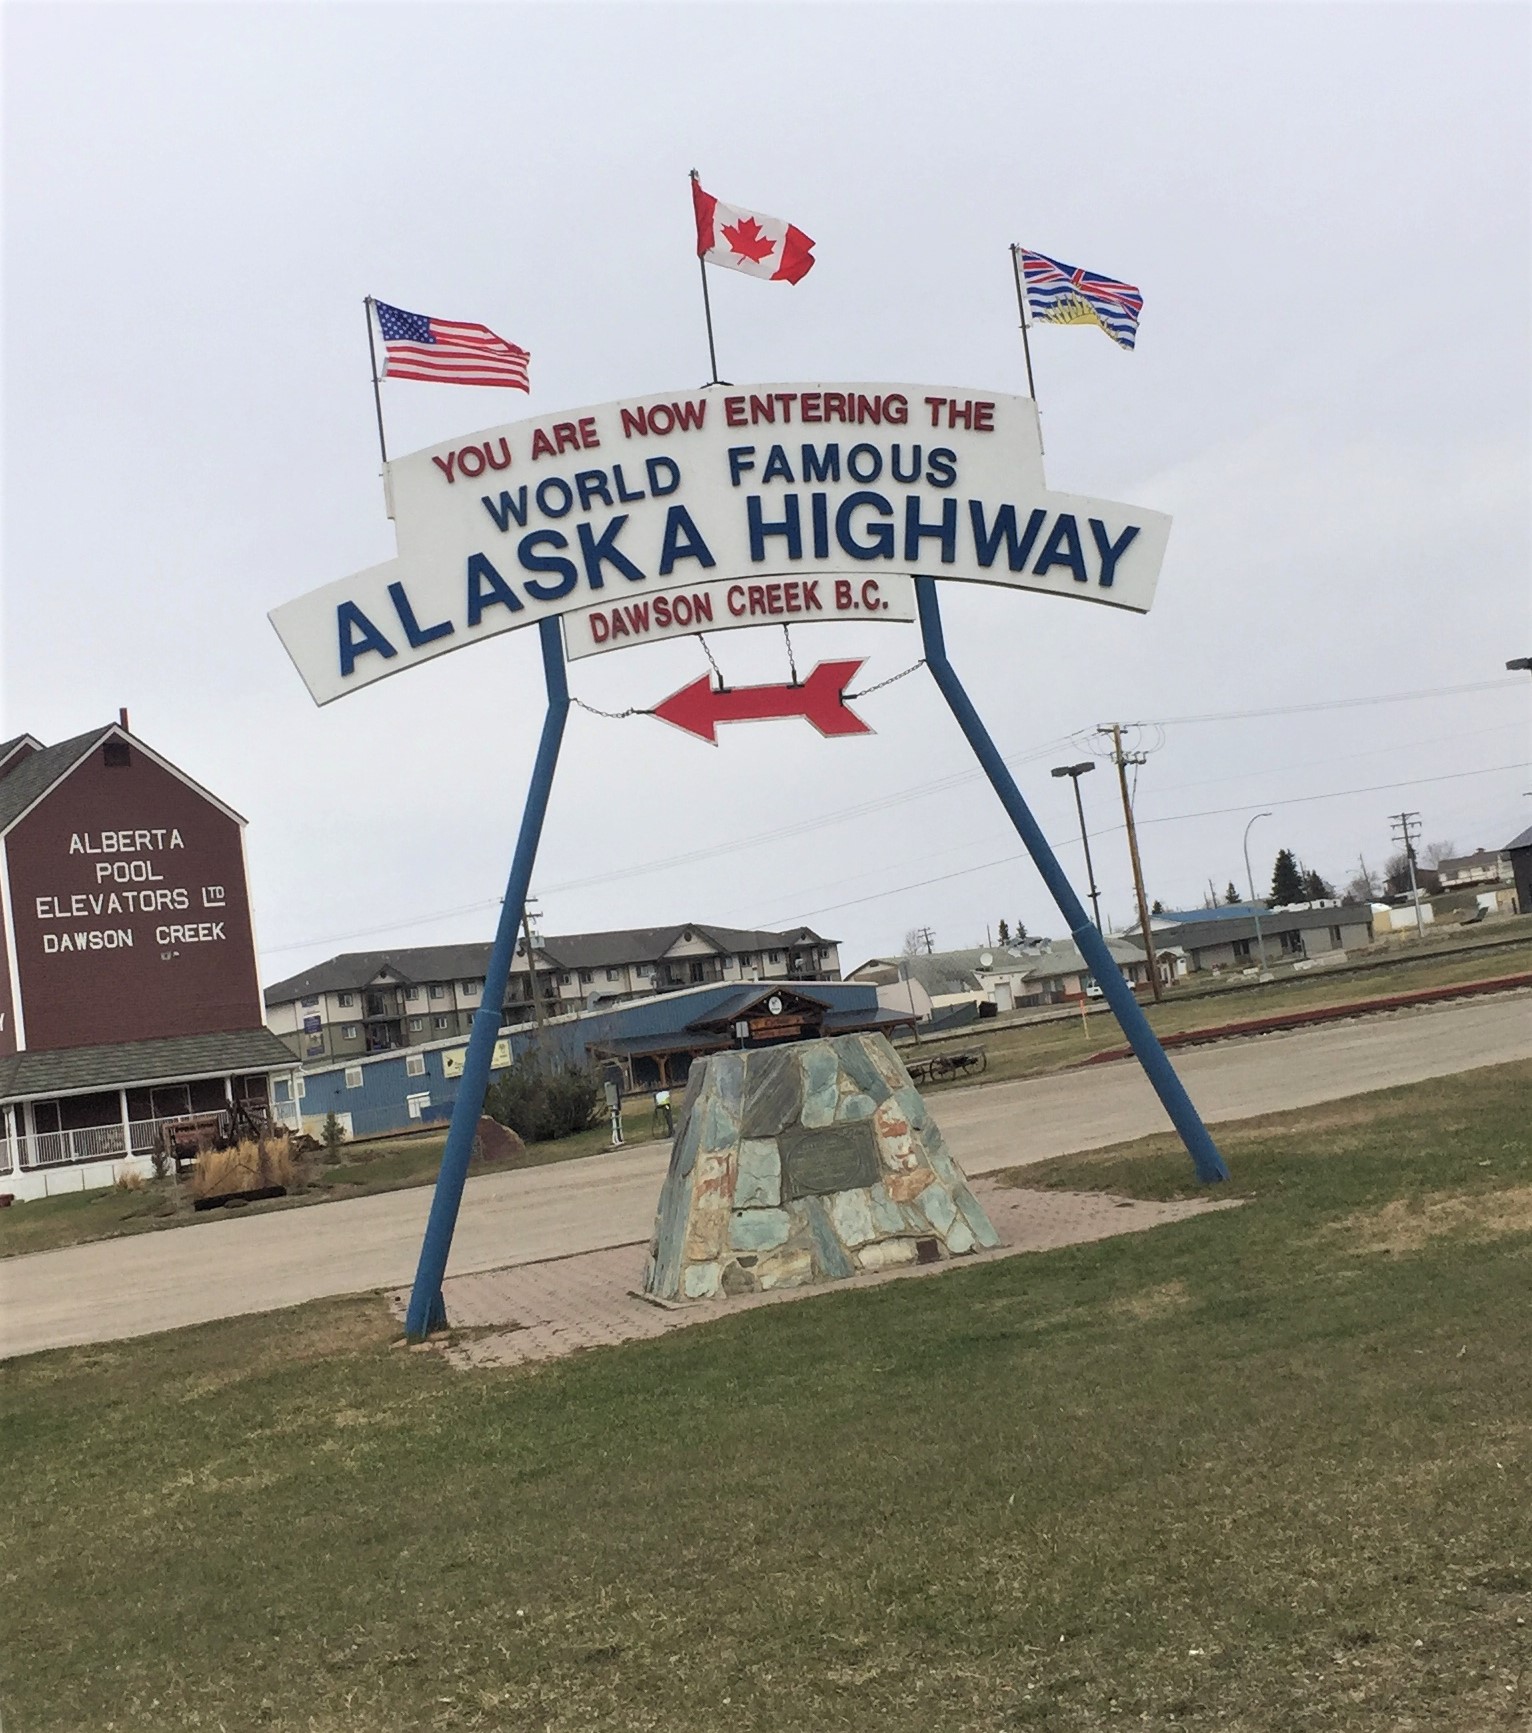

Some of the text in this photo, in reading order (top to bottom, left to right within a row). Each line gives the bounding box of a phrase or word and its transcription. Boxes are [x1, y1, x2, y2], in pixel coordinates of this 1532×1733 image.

[433, 394, 996, 482] YOU ARE NOW ENTERING THE
[482, 442, 957, 533] WORLD FAMOUS
[336, 489, 1140, 678] ALASKA HIGHWAY
[589, 579, 890, 643] DAWSON CREEK B.C.
[69, 828, 185, 855] ALBERTA
[95, 860, 164, 884] POOL
[36, 887, 190, 919] ELEVATORS
[42, 922, 227, 954] DAWSON CREEK
